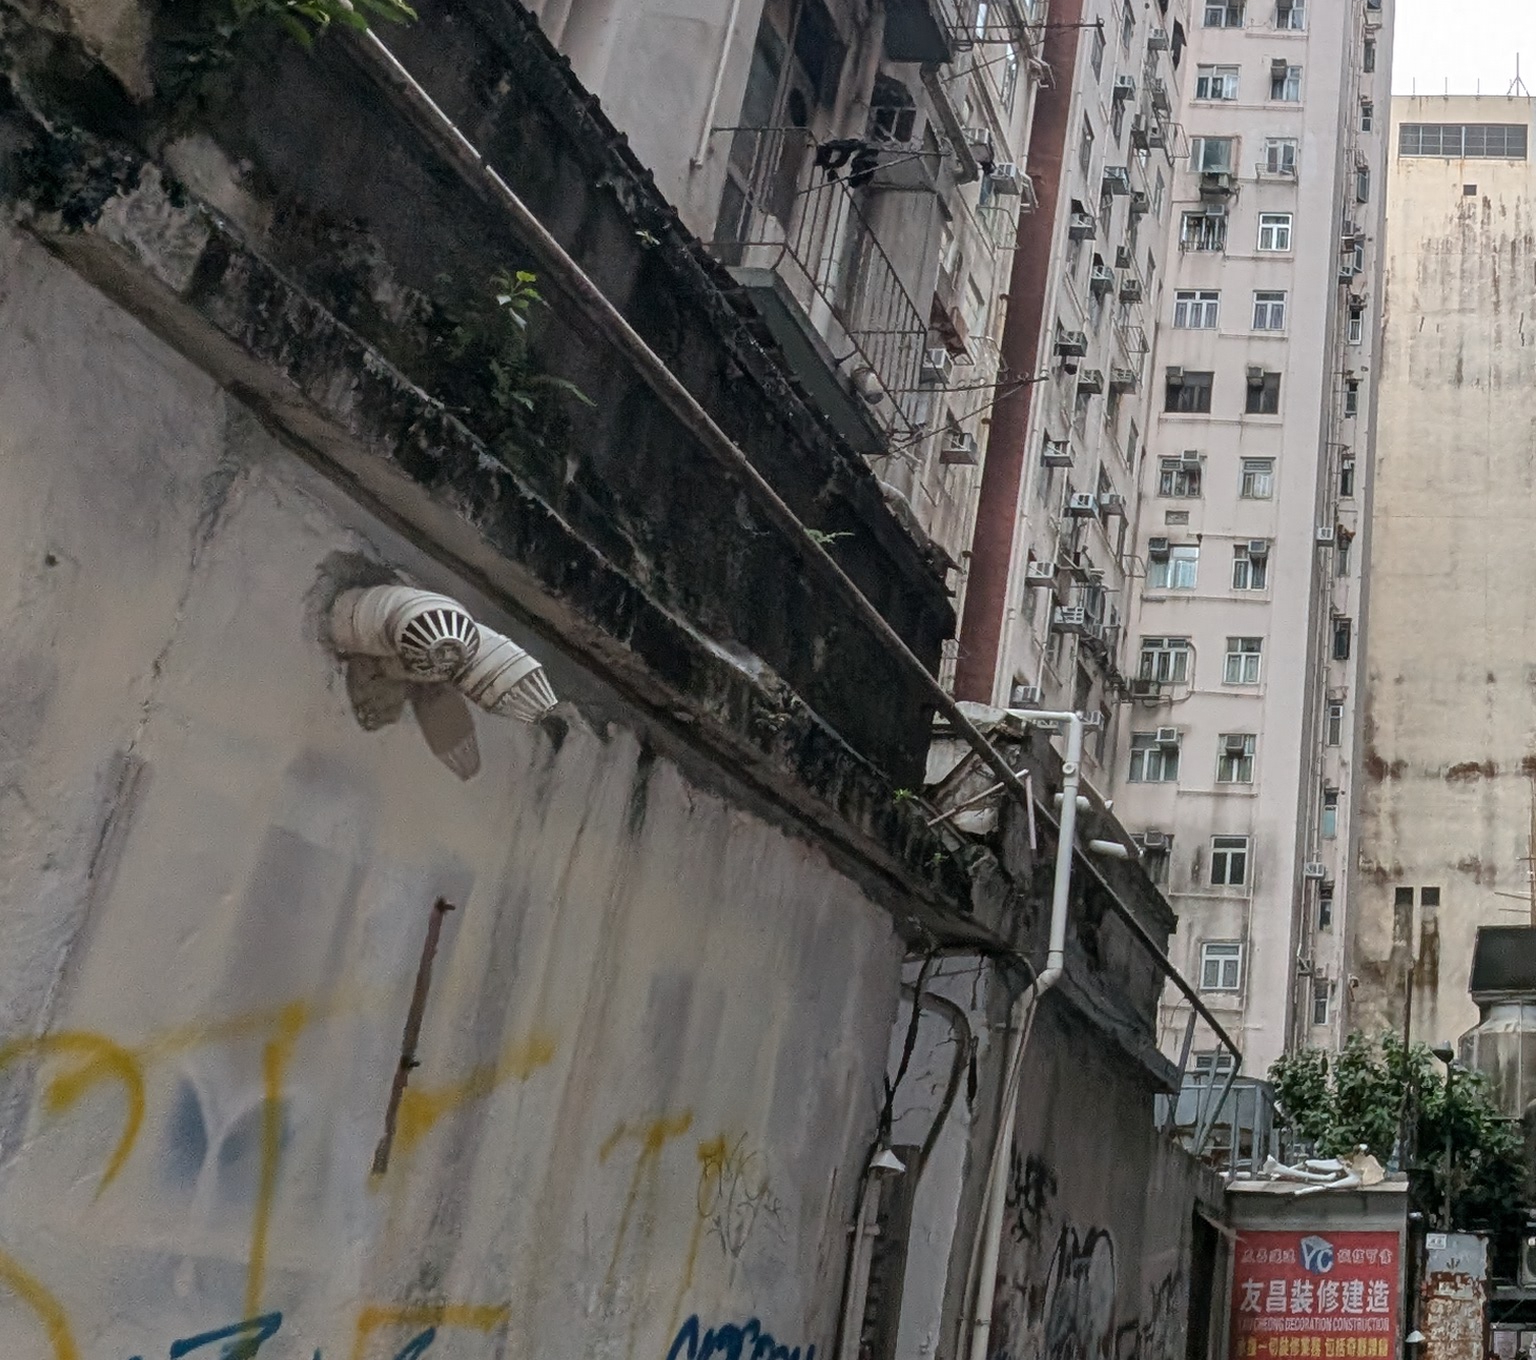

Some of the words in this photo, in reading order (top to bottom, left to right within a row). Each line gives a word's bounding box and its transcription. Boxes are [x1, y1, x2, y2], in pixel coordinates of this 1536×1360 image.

[1239, 1278, 1390, 1314] 友昌裝修建造
[1285, 1317, 1332, 1332] DECORATION
[1333, 1317, 1390, 1332] CONSTRUCTION
